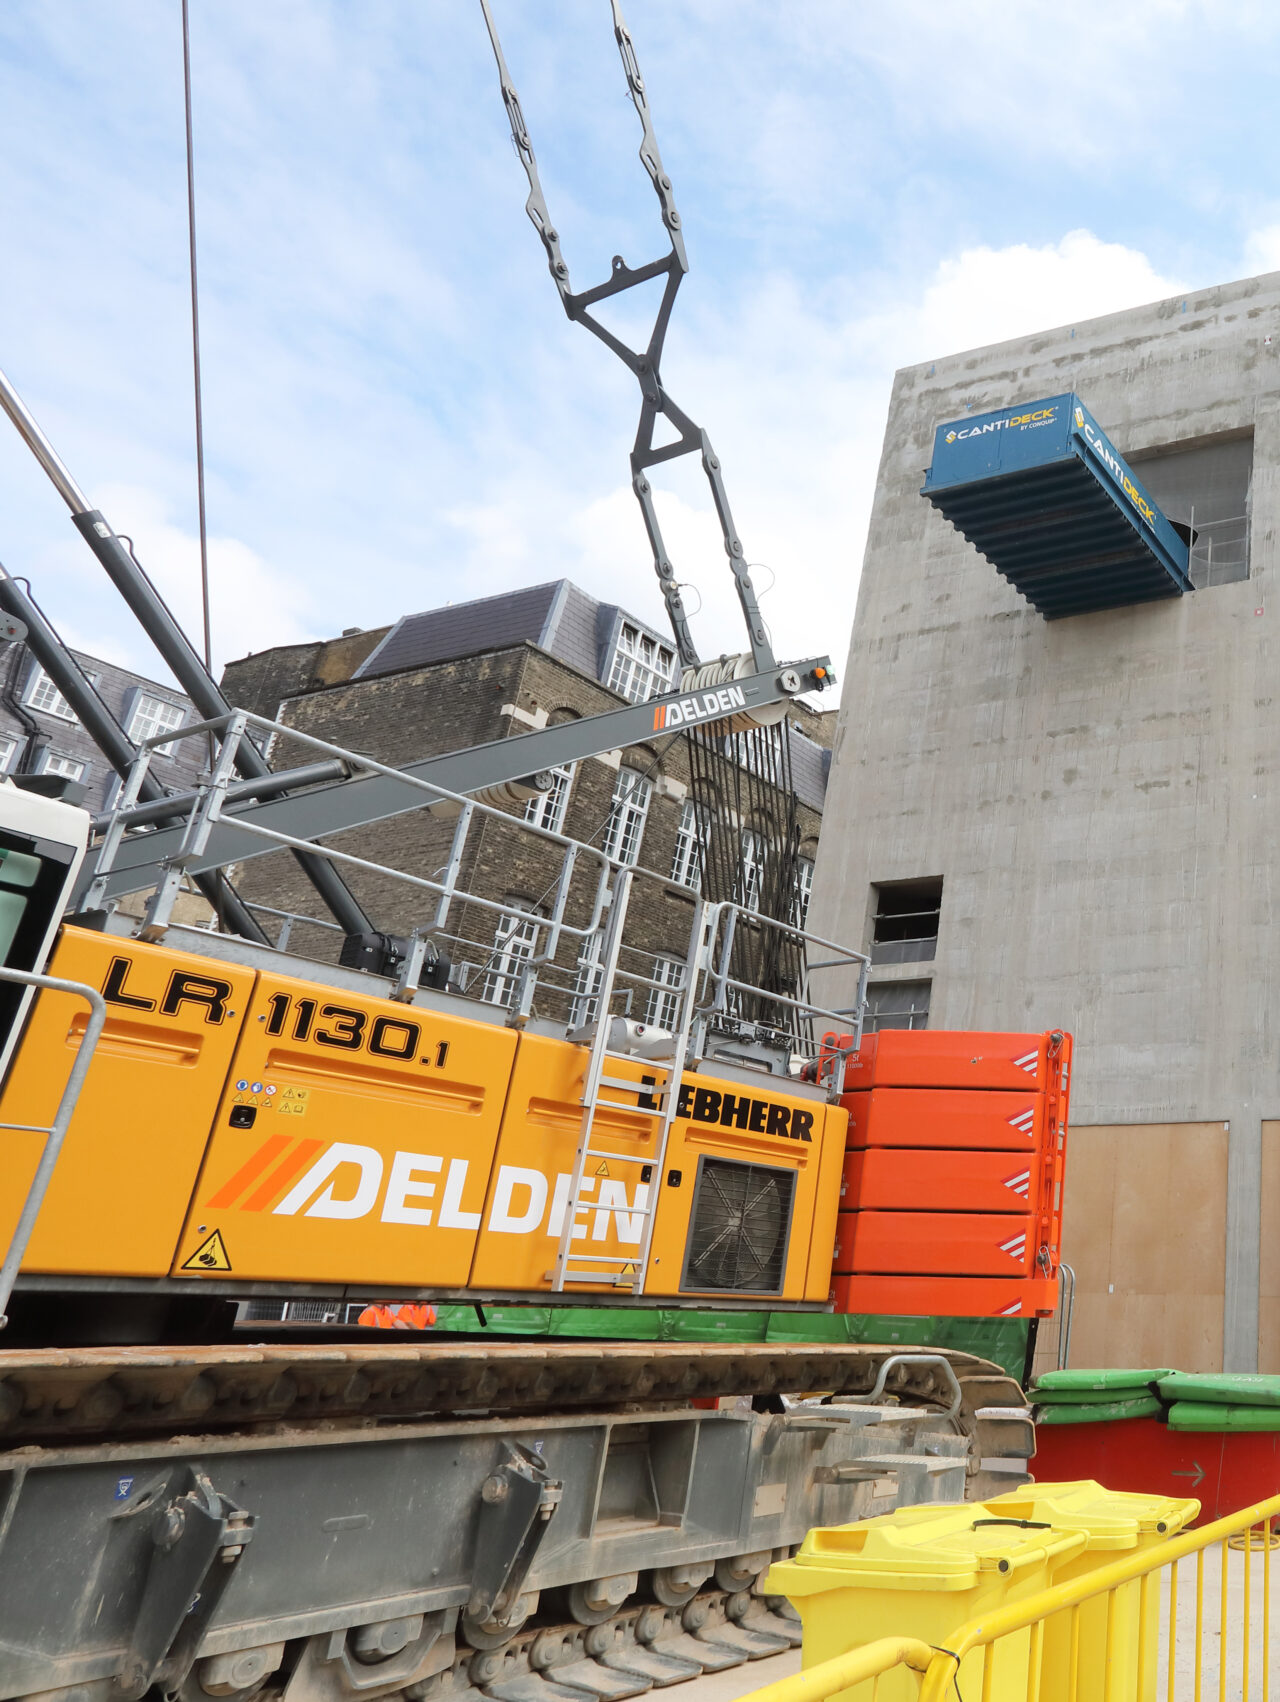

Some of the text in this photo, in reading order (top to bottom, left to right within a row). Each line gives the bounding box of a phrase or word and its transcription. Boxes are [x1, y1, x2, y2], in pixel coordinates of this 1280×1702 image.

[957, 407, 1056, 440] CANTIDECK
[1084, 423, 1154, 525] CANTIDECK
[664, 686, 746, 728] DELDEN
[102, 955, 450, 1070] LR 1130.1
[637, 1074, 814, 1142] LEBHERR
[272, 1141, 650, 1246] DELDEN
